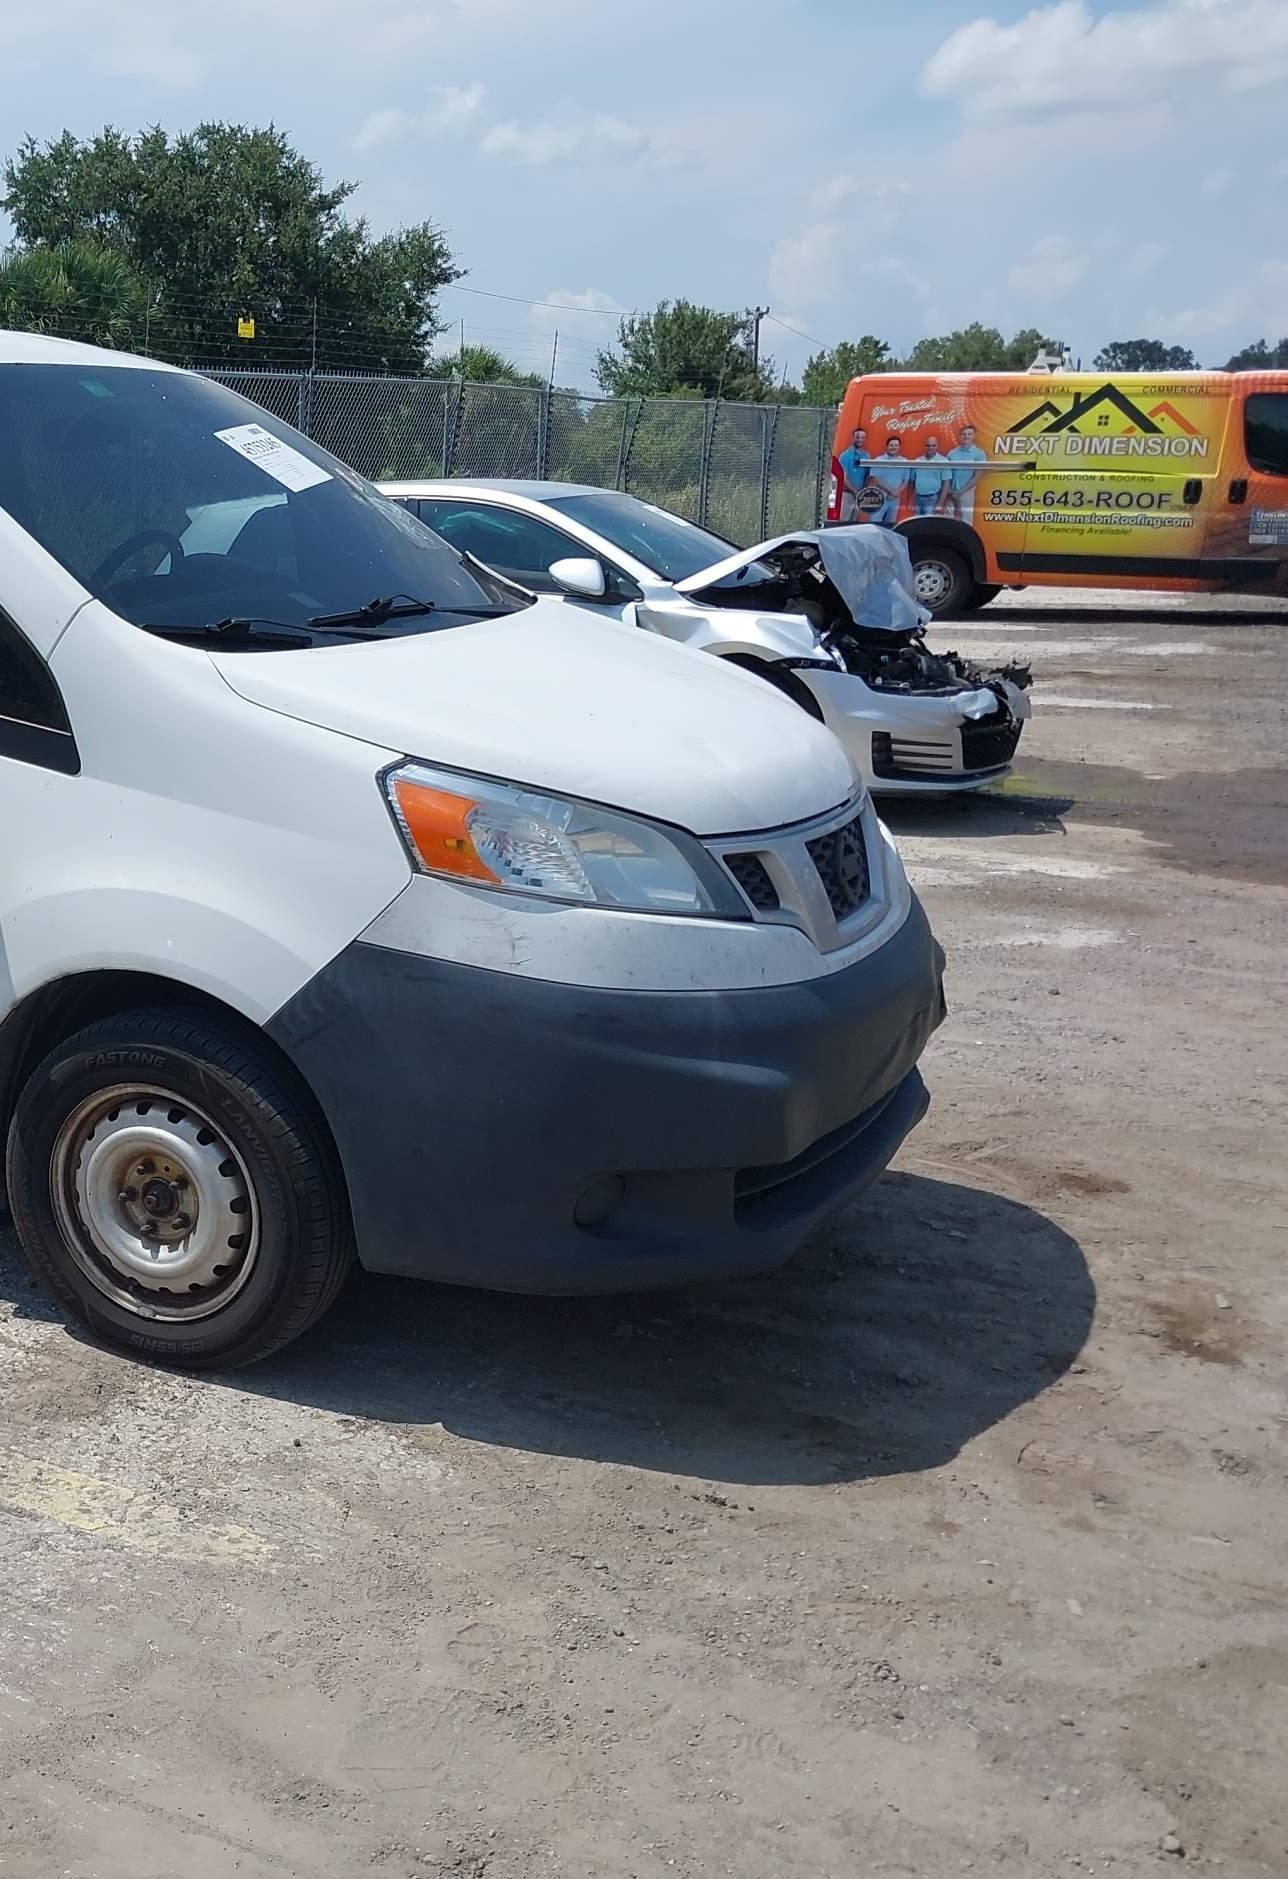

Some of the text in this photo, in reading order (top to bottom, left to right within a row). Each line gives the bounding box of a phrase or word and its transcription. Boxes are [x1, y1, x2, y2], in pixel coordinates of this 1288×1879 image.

[1009, 385, 1070, 395] RESIDENTIAL
[1143, 385, 1209, 394] COMMERCIAL
[871, 406, 895, 423] Your
[886, 417, 921, 434] Roofing
[994, 436, 1209, 457] NEXT DIMENSION
[1018, 473, 1095, 482] CONSTRUCTION
[1110, 475, 1155, 483] ROOFING
[990, 489, 1173, 509] 855-643-ROOF
[983, 512, 1193, 528] www.NextDimensionRoofing.com
[1041, 525, 1085, 536] Financing
